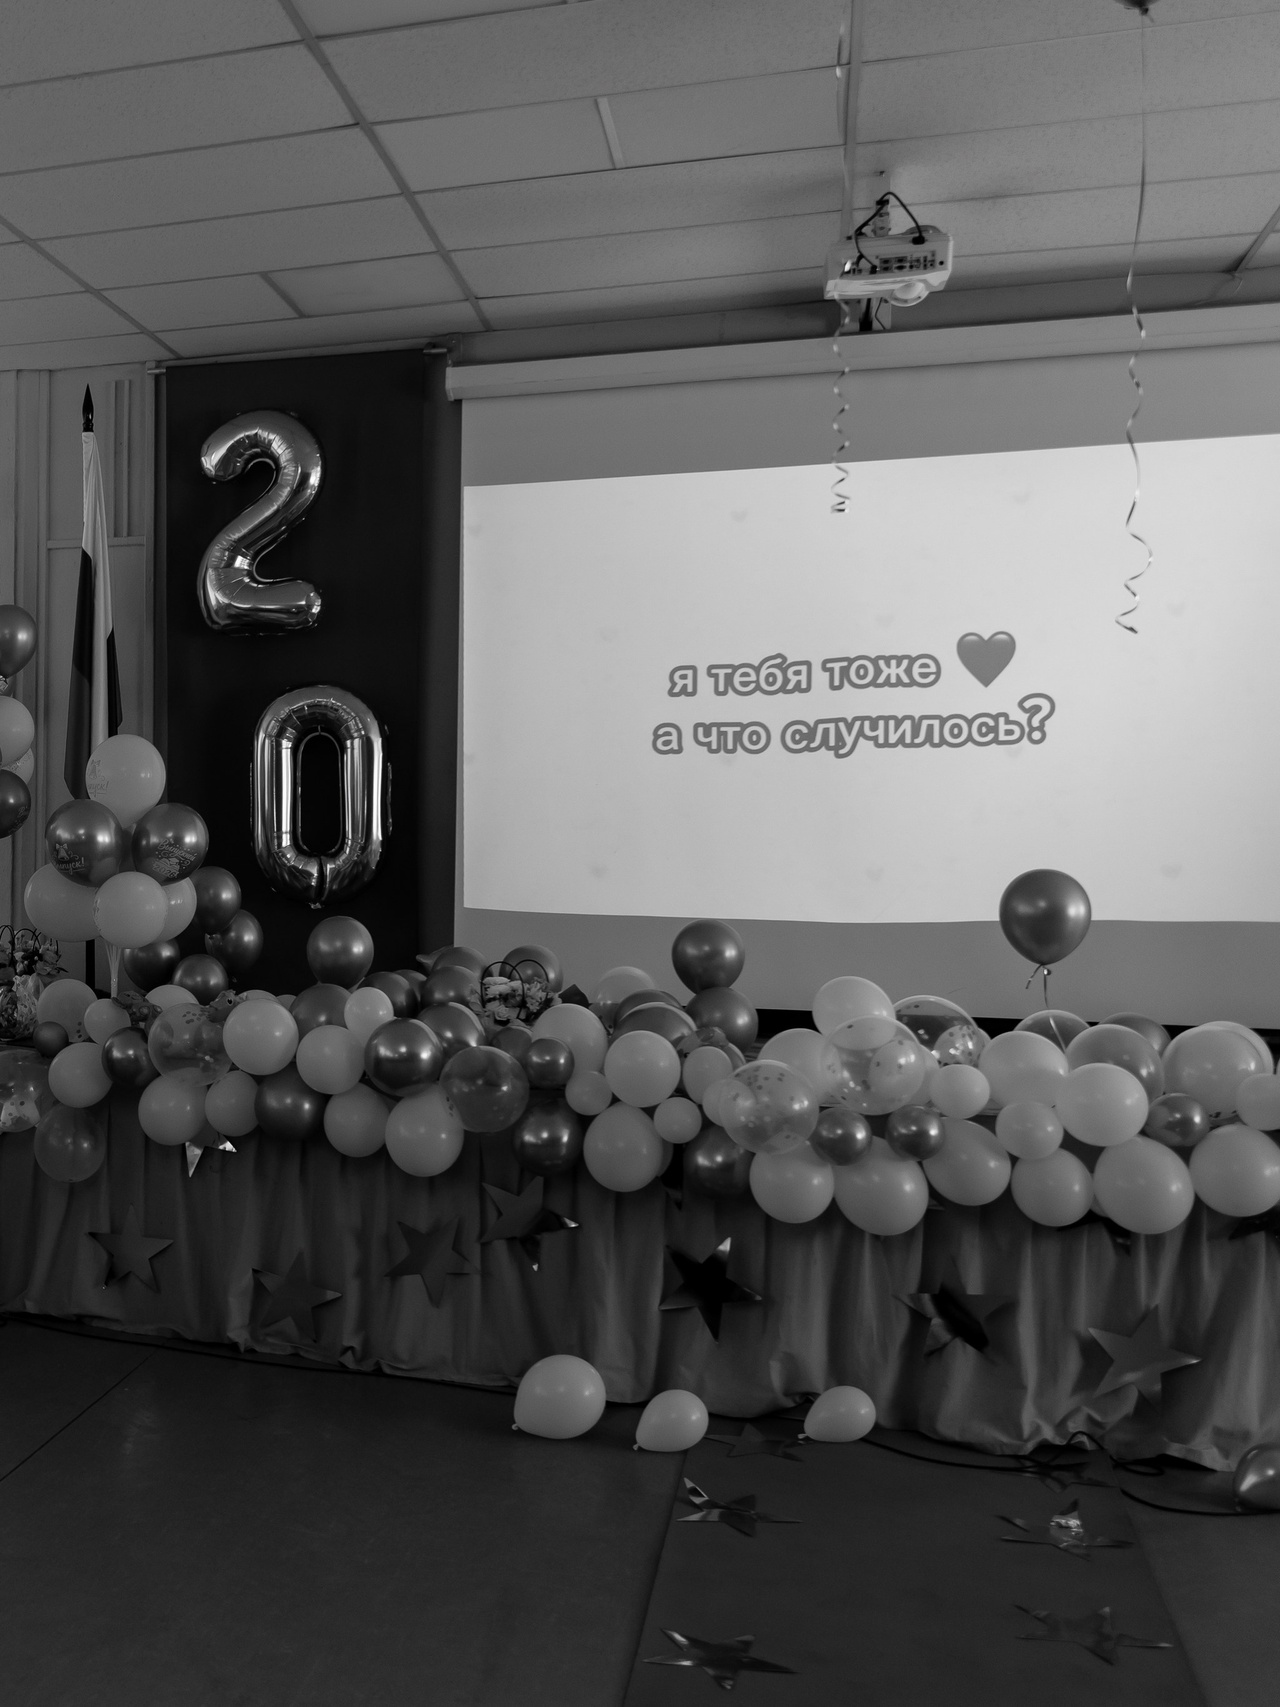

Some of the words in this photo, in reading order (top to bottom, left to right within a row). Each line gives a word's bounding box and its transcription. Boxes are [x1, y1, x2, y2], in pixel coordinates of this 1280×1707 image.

[197, 409, 322, 635] 2
[667, 665, 698, 698] я
[706, 653, 812, 697] тебя
[821, 653, 942, 692] тоже
[652, 722, 684, 755] а
[693, 721, 771, 755] что
[780, 692, 1056, 759] случилось?
